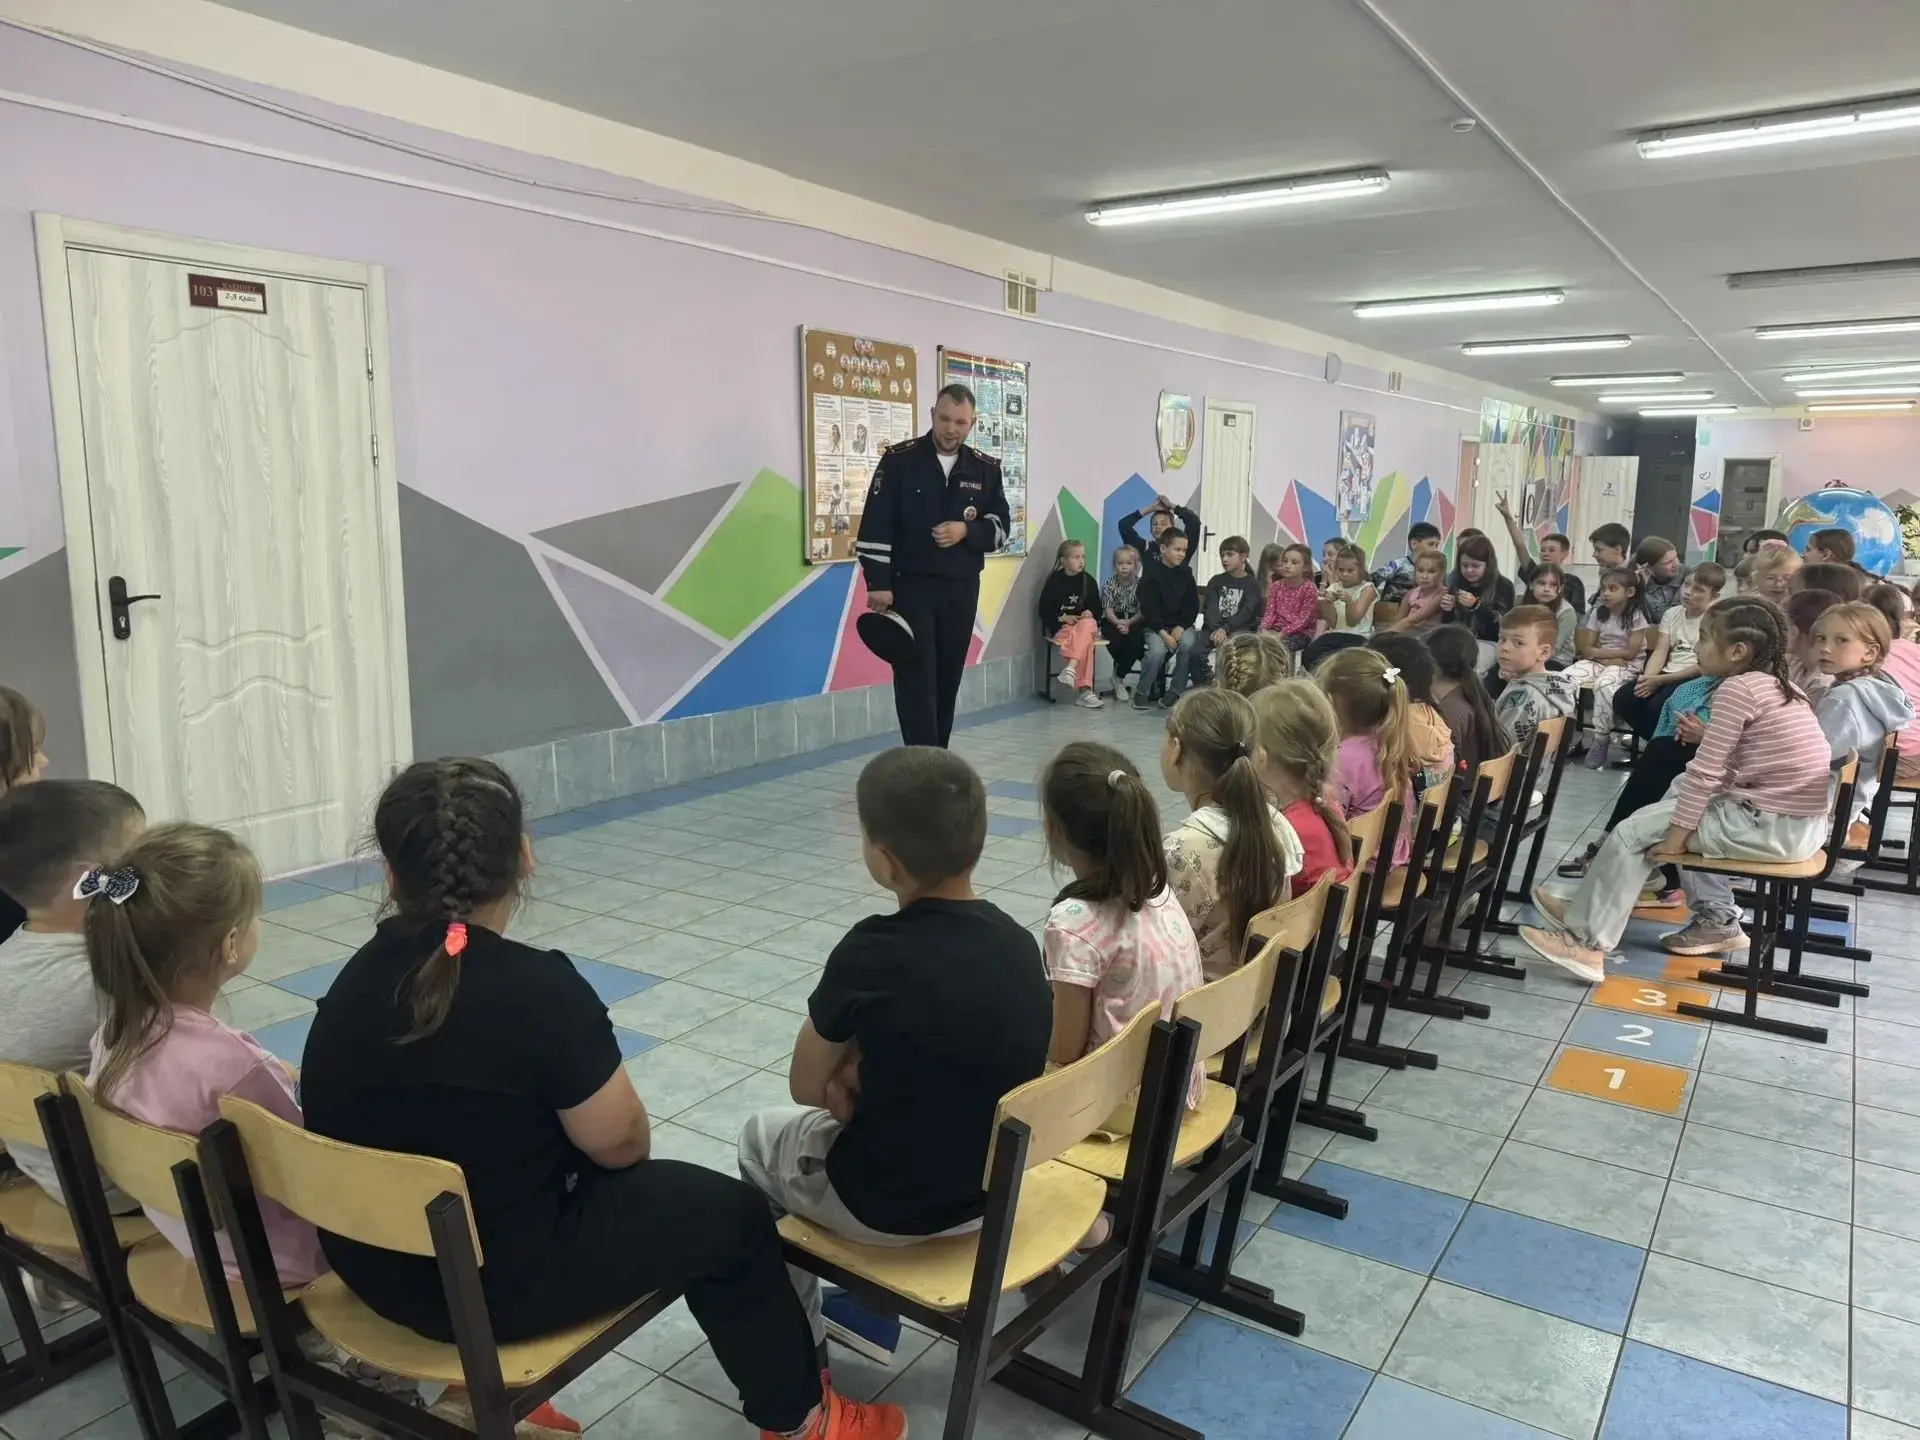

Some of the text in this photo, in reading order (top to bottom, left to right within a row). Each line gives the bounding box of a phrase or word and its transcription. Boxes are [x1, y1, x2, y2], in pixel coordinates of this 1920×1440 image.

[192, 285, 213, 296] 103
[1631, 988, 1668, 1007] 3
[1615, 1023, 1654, 1046] 2
[1603, 1068, 1627, 1089] 1
